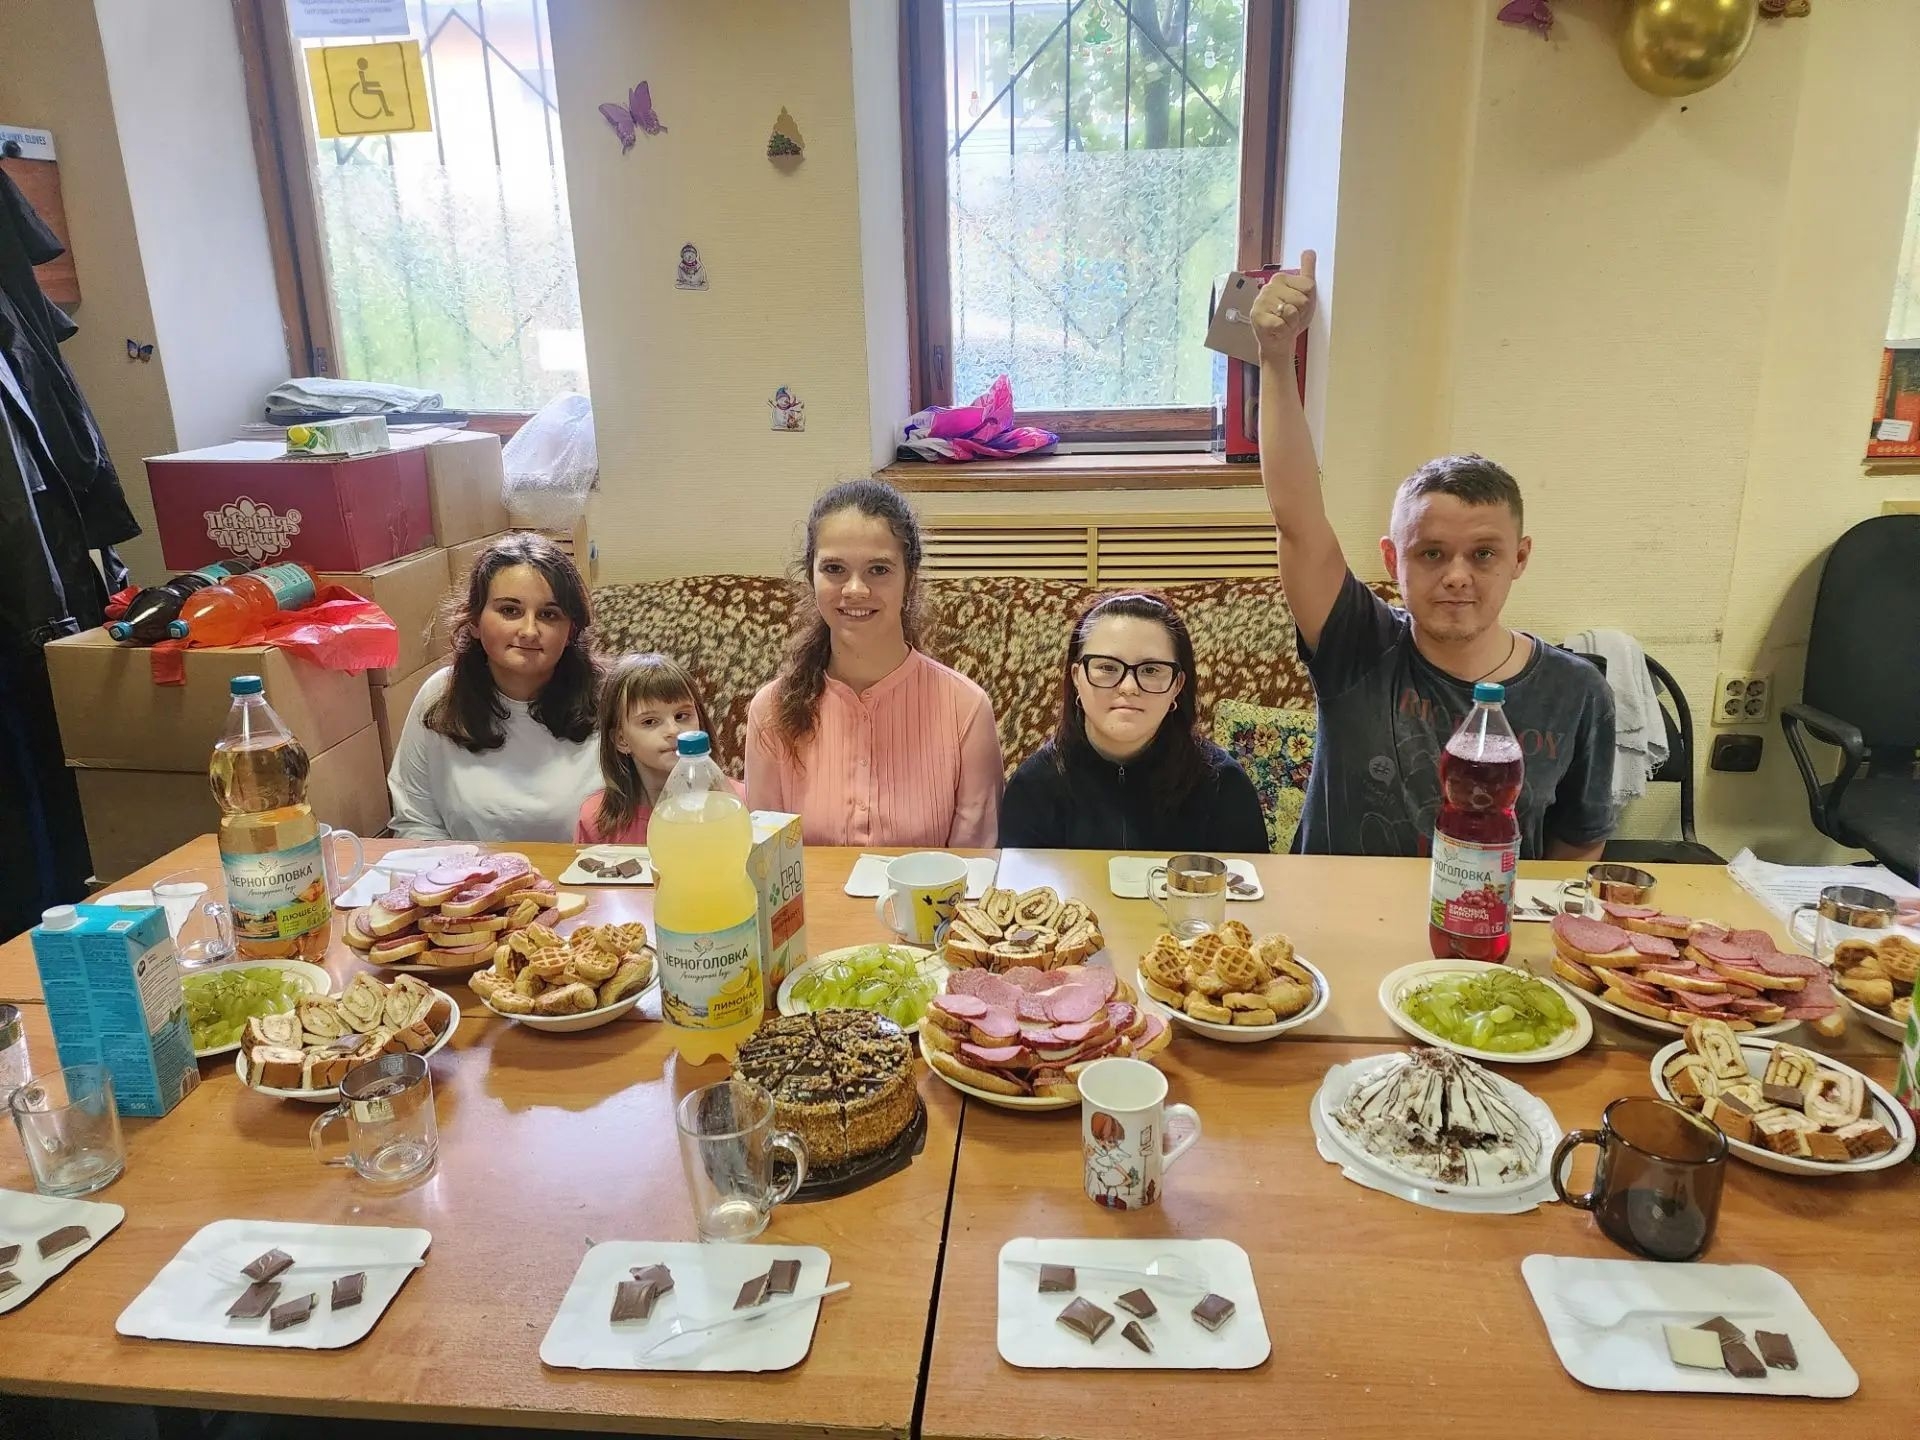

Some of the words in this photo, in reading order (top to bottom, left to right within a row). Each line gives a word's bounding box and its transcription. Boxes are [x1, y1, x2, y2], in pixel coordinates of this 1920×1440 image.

[24, 134, 46, 145] GLOVES
[229, 864, 314, 888] ЧЕРНОГОЛОВКА
[1434, 859, 1492, 882] НОГОЛОВКА
[282, 906, 318, 923] ДЮШЕС
[1449, 904, 1487, 915] КРАСНЫЙ
[1449, 908, 1489, 921] ВИНОГРАД
[662, 946, 750, 971] ЧЕРНОГОЛОВКА
